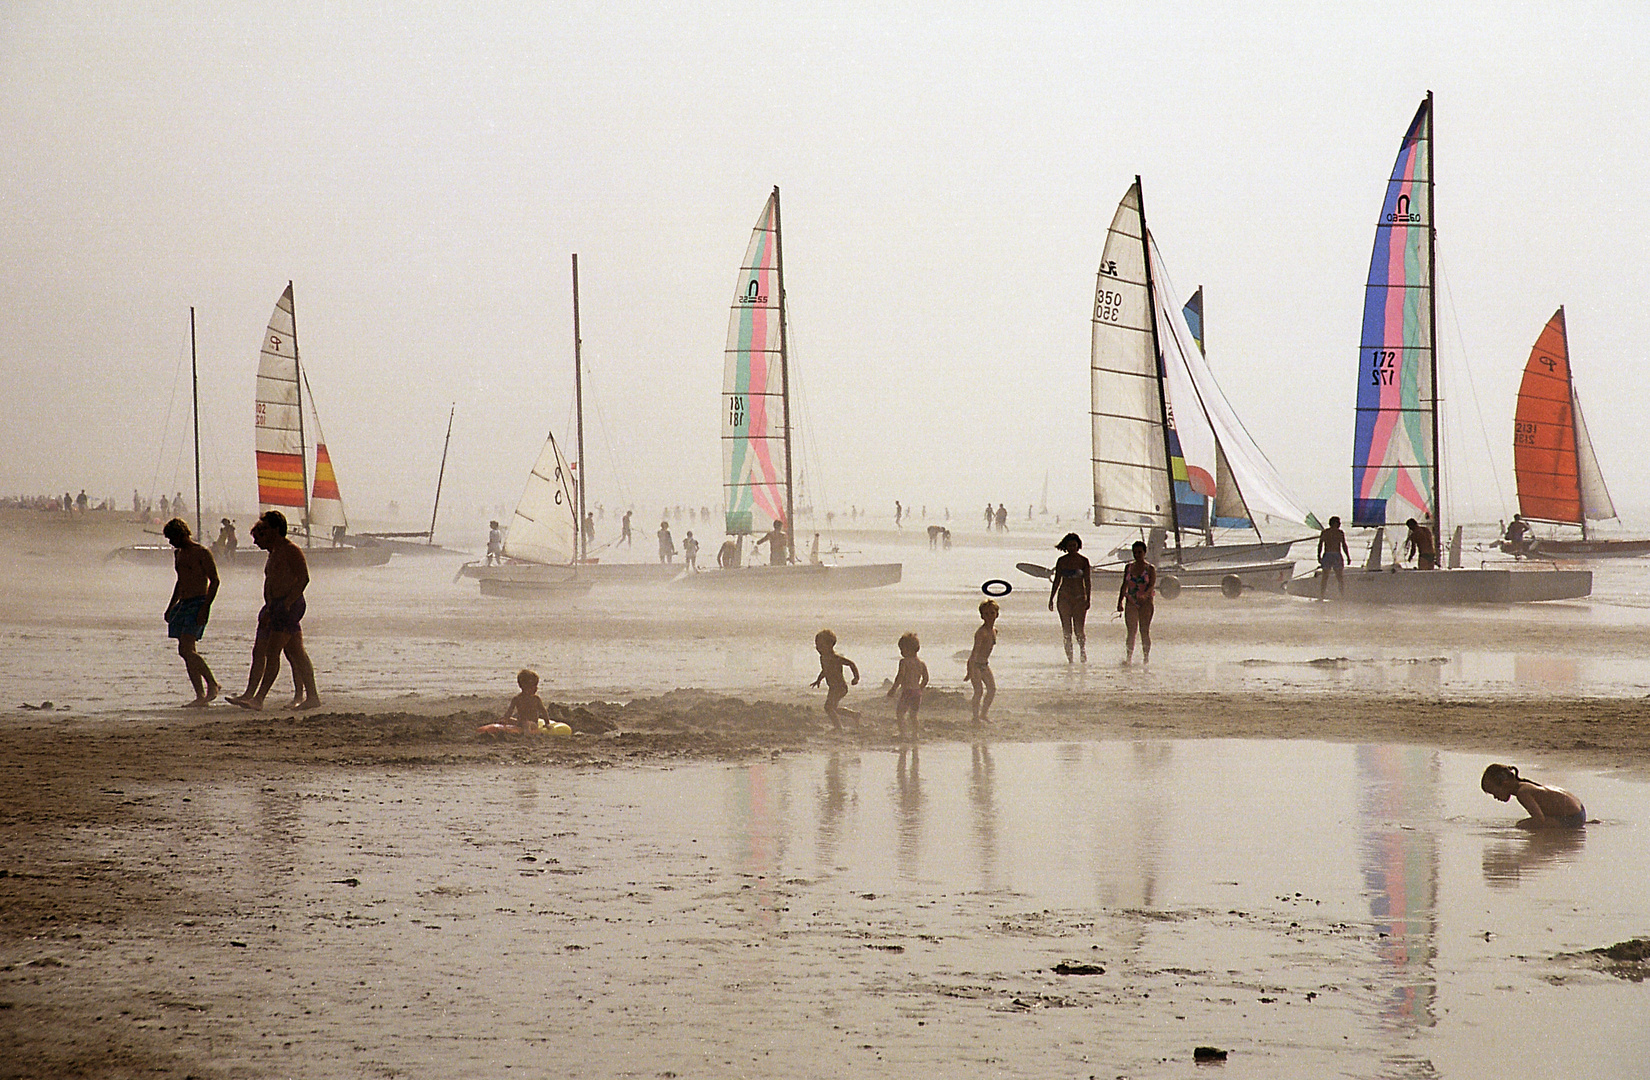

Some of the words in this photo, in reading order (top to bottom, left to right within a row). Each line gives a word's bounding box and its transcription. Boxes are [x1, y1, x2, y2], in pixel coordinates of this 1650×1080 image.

[1097, 289, 1122, 307] 350
[1373, 351, 1395, 368] 172
[1516, 422, 1537, 434] 2131
